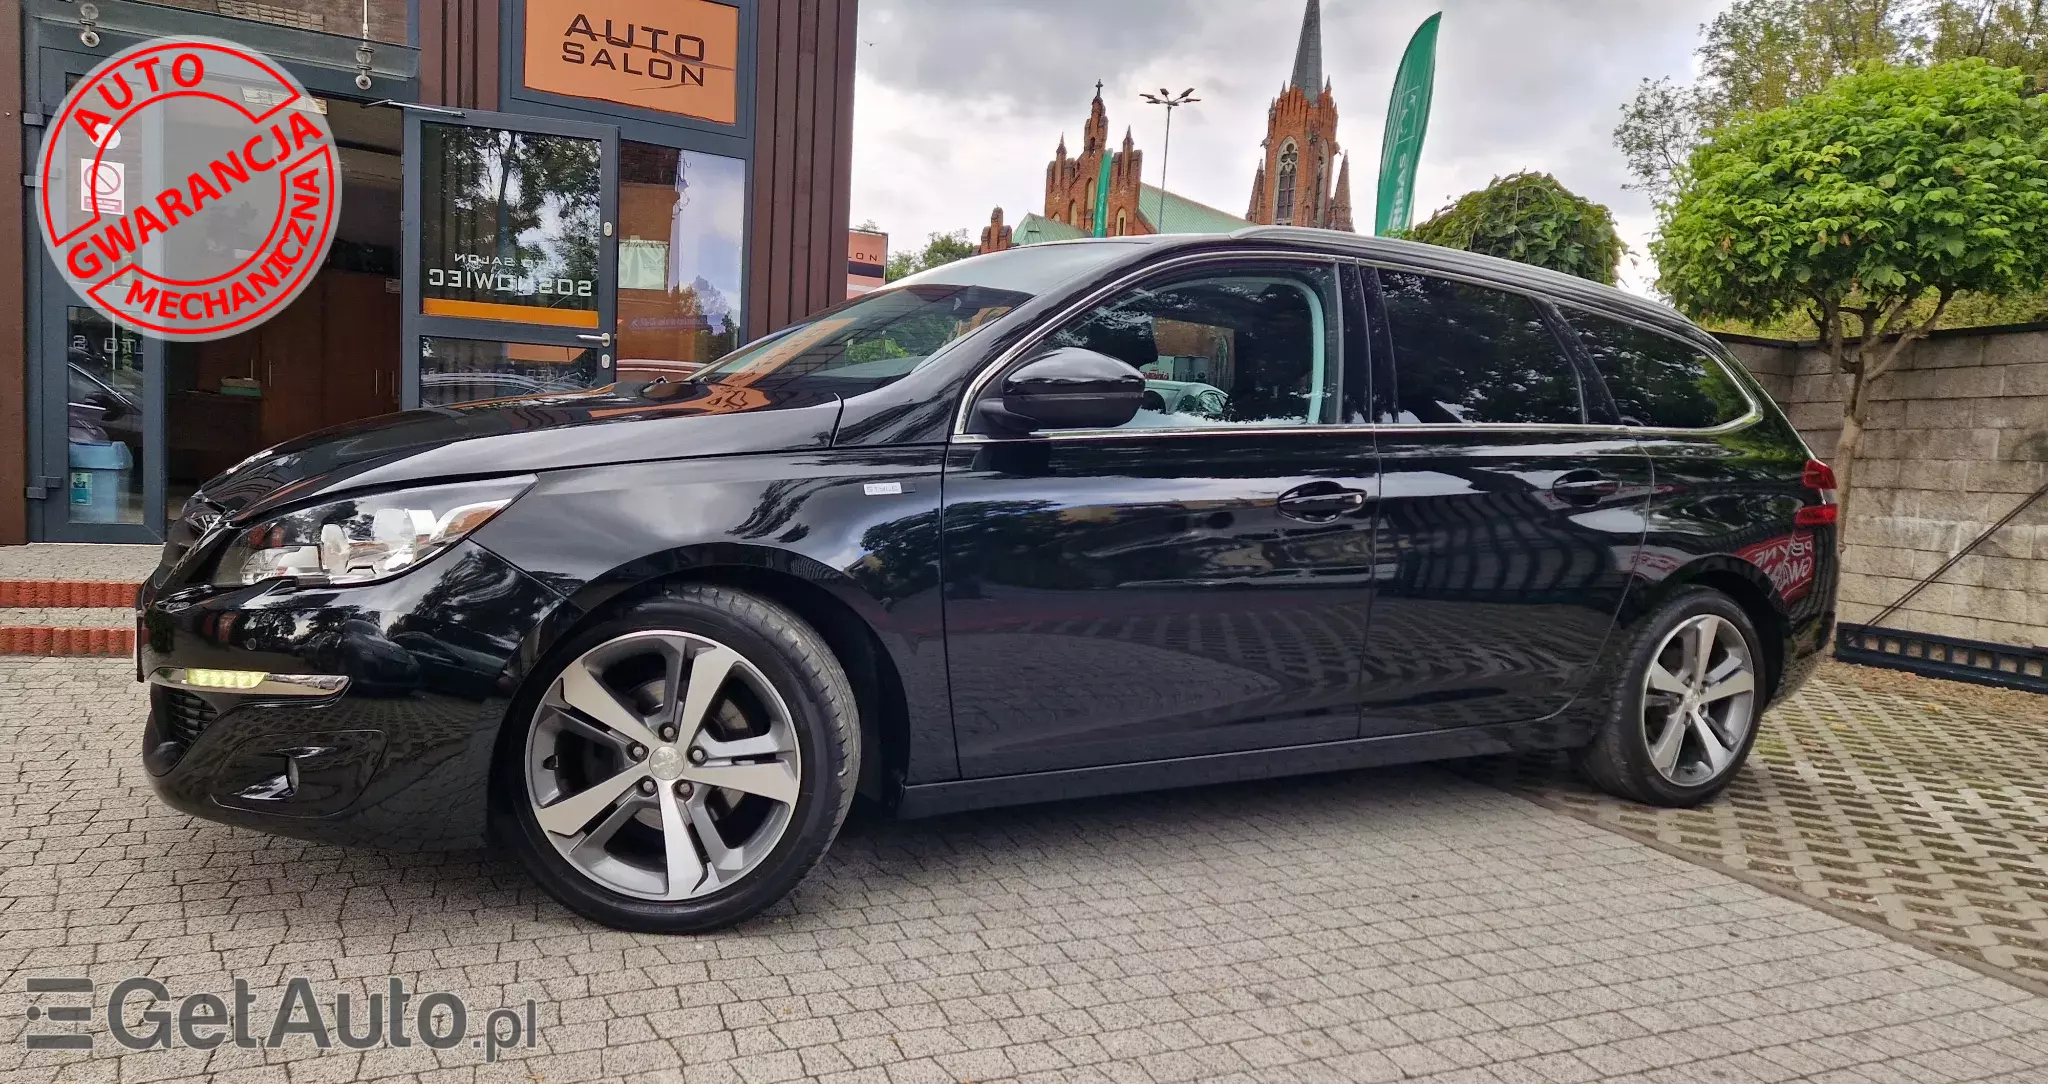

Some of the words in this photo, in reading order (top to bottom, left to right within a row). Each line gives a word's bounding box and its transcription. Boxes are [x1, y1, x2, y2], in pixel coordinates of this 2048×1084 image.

[564, 13, 705, 62] AUTO
[561, 41, 704, 87] SALON
[849, 252, 877, 262] ON
